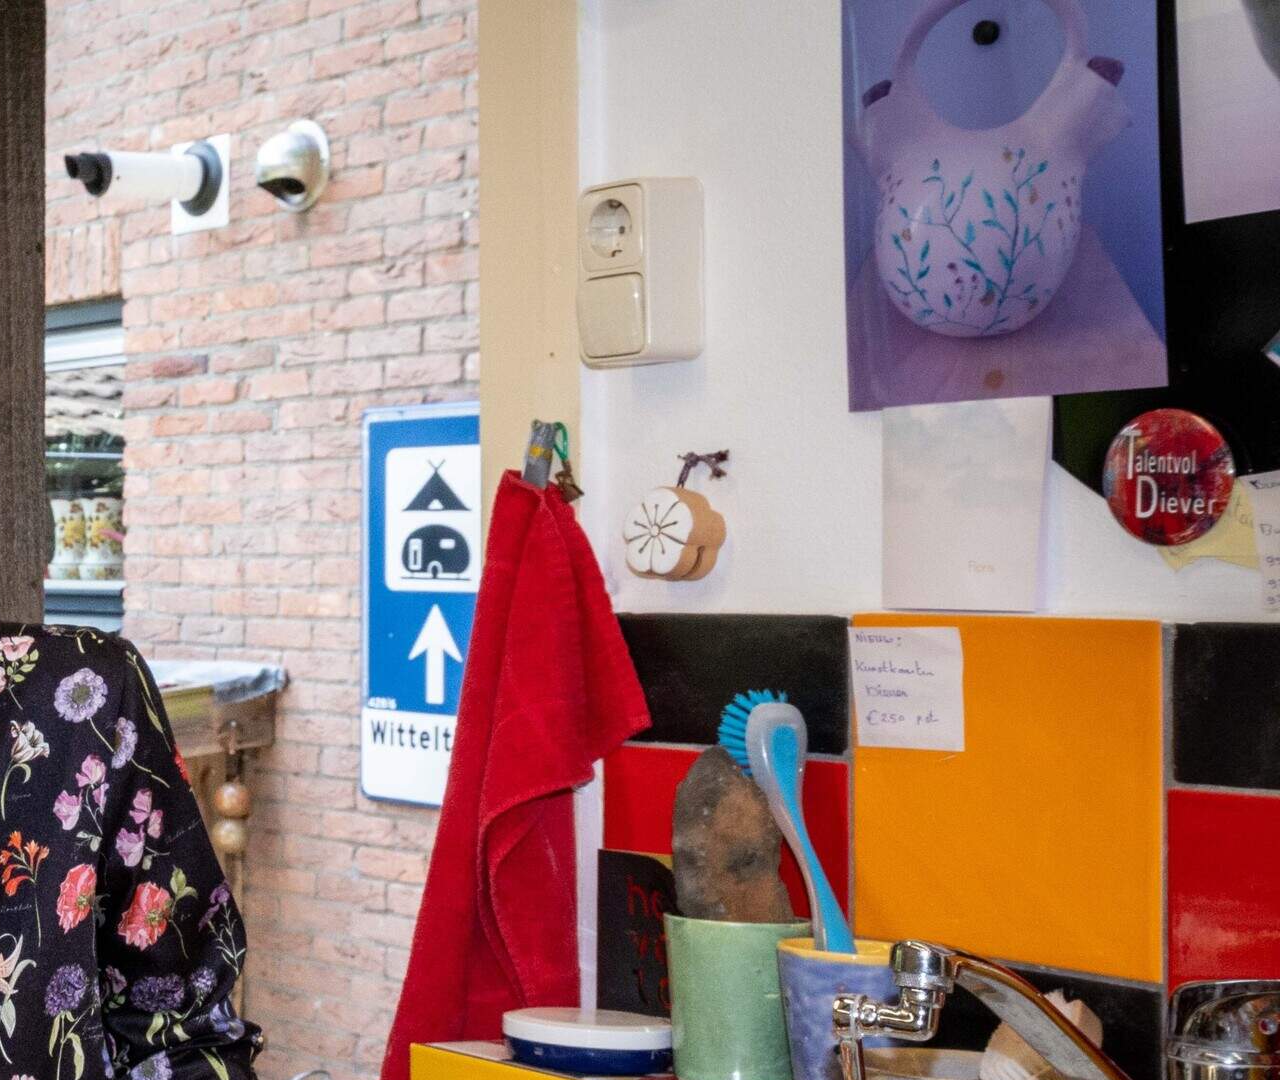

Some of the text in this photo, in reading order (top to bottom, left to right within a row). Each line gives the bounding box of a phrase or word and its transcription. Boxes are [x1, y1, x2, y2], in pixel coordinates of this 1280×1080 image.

[1120, 429, 1197, 480] Talentvol
[1135, 474, 1216, 519] Diever
[371, 720, 451, 752] Wittelt
